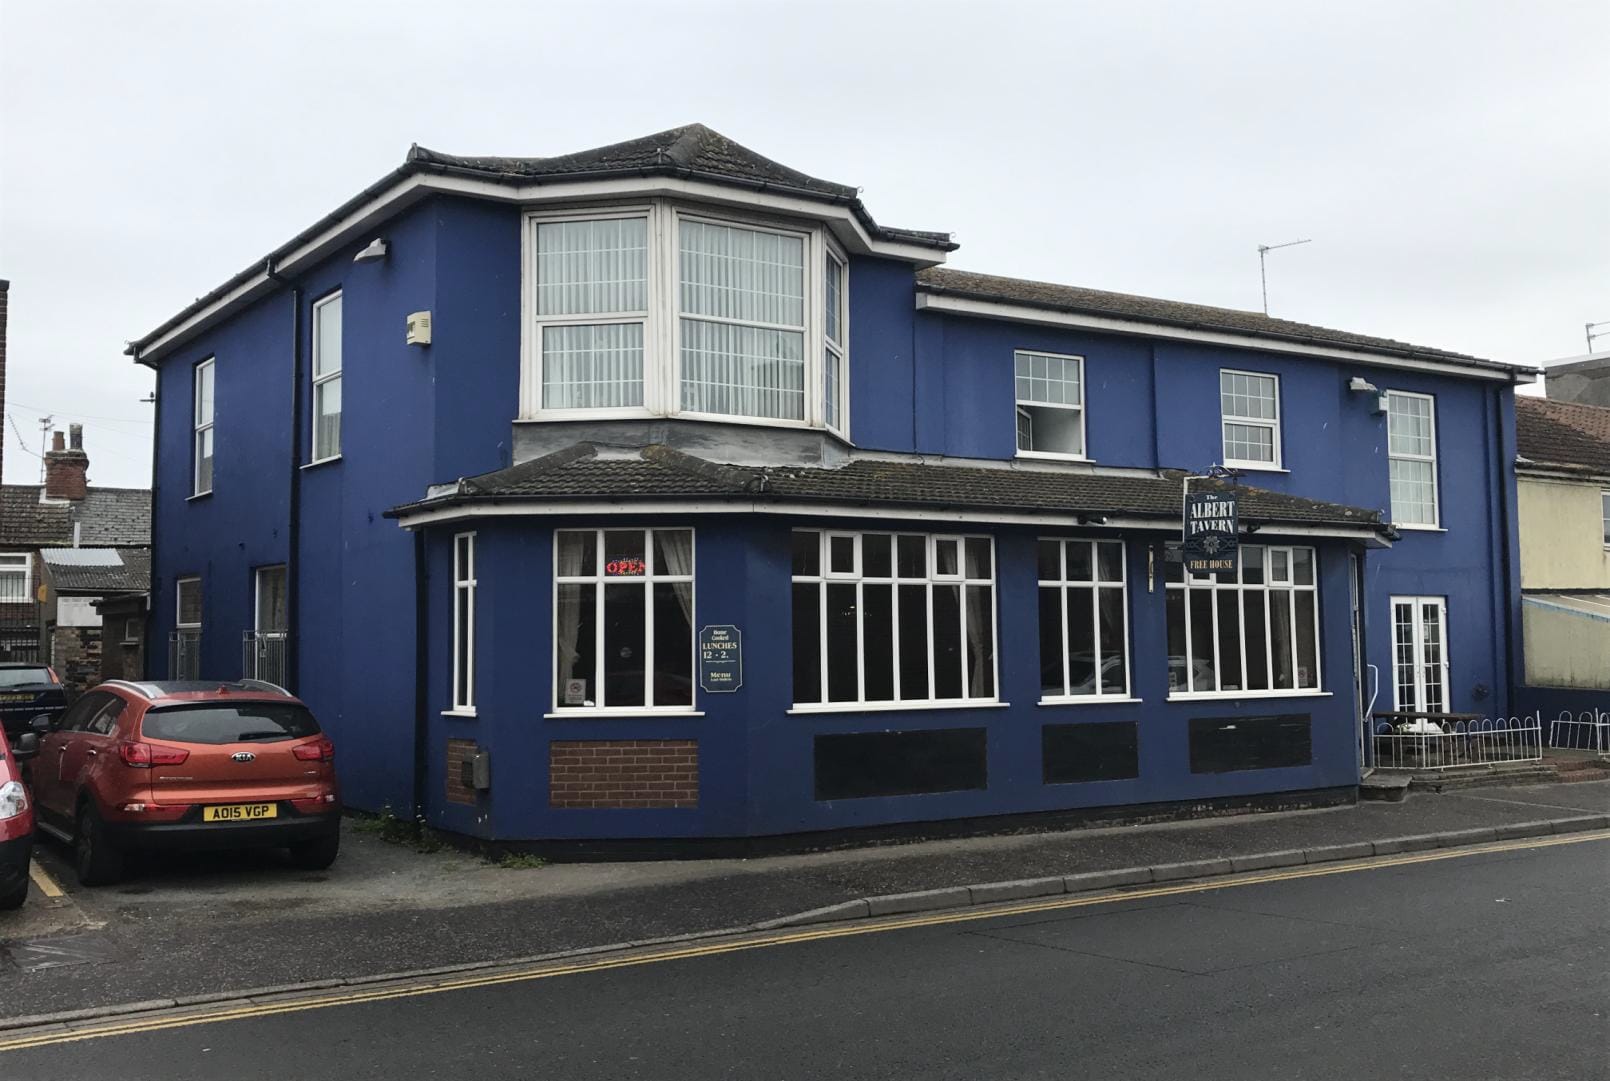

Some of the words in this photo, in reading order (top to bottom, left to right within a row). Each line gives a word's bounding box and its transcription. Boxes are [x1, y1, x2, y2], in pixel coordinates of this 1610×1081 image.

[1190, 501, 1235, 518] ALBERT
[1190, 520, 1234, 534] TAVERN
[1190, 560, 1206, 568] FREE
[1210, 560, 1232, 568] HOUSE
[213, 807, 241, 819] AO15
[245, 805, 269, 817] VGP
